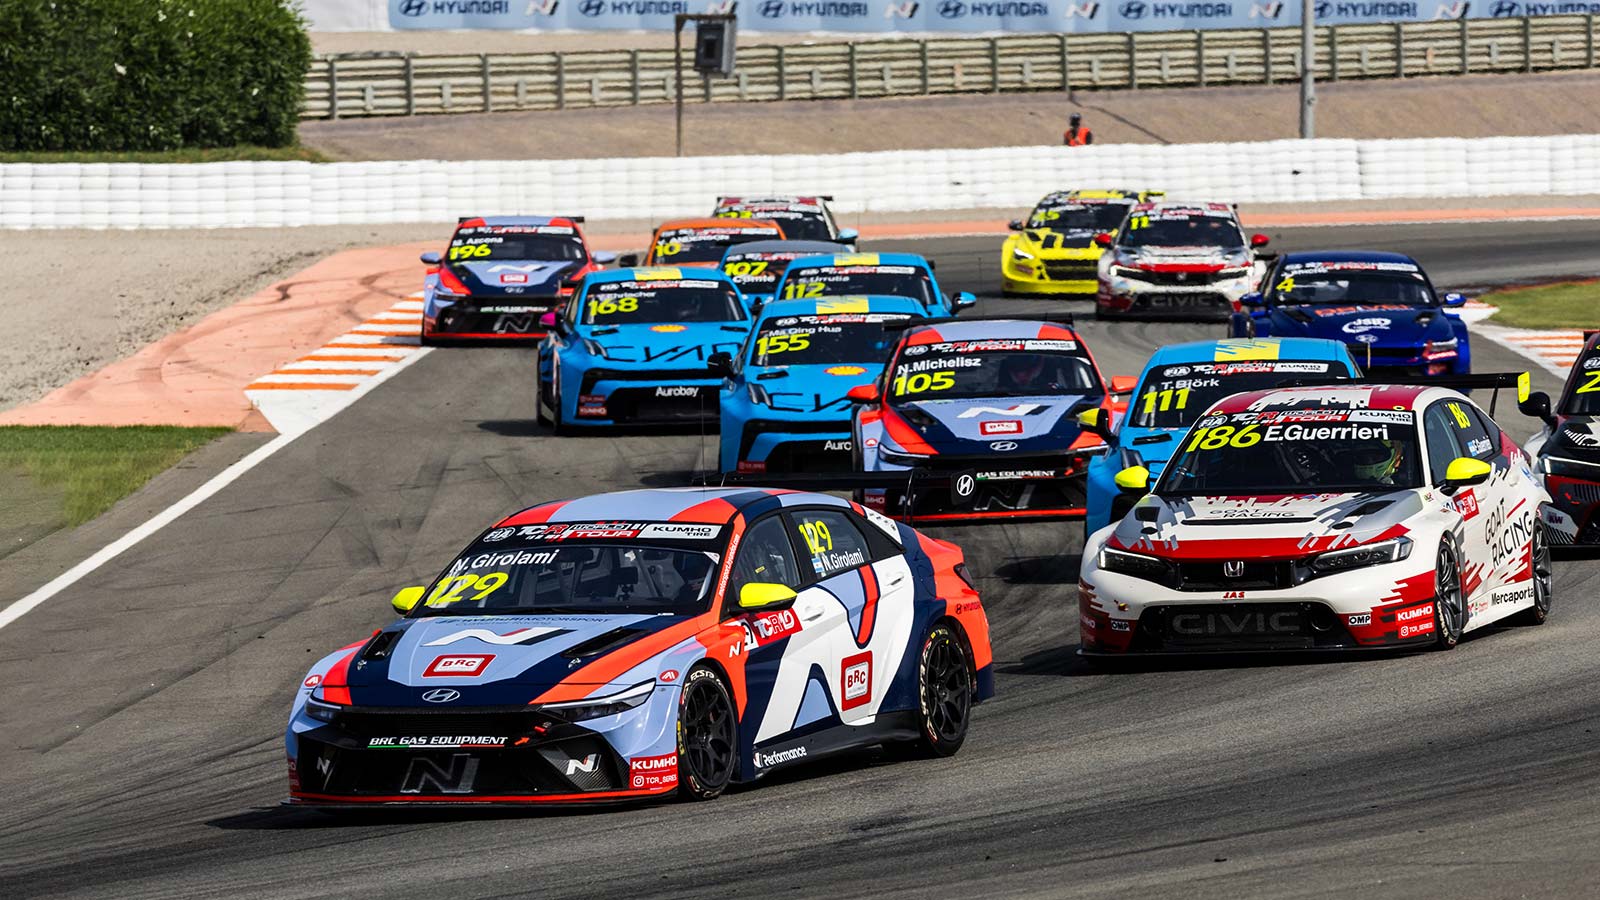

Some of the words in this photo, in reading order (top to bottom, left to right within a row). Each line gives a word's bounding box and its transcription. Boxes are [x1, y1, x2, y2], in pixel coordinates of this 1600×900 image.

[433, 0, 508, 14] HYUNDAI
[612, 1, 687, 14] HYUNDAI
[791, 1, 867, 16] HYUNDAI
[971, 1, 1048, 16] HYUNDAI
[1153, 2, 1232, 17] HYUNDAI
[1337, 2, 1417, 17] HYUNDAI
[450, 244, 491, 260] 196
[655, 243, 680, 257] 10
[724, 262, 768, 276] 107
[785, 282, 825, 299] 112
[1276, 278, 1295, 293] 4
[588, 298, 638, 316] 168
[1151, 292, 1211, 307] CIVIC
[757, 334, 810, 355] 155
[897, 357, 981, 375] N.Michelisz
[1164, 366, 1190, 377] FIA
[895, 371, 955, 396] 105
[1161, 378, 1219, 391] T.Björk
[655, 387, 699, 397] Aurobay
[1143, 388, 1190, 414] 111
[1199, 415, 1228, 429] FIA
[1231, 411, 1279, 422] TCR
[1186, 424, 1261, 452] 186
[1264, 423, 1388, 442] E.Guerrieri
[999, 470, 1055, 478] EQUIPMENT
[1485, 497, 1505, 545] GOAT
[483, 527, 516, 542] FIA
[516, 523, 569, 536] TCR
[576, 530, 634, 538] TOUR
[798, 520, 833, 554] 129
[1492, 511, 1532, 569] RACING
[449, 548, 560, 575] N.Girolami
[822, 548, 864, 571] N.Girolami
[424, 572, 510, 607] 129
[1222, 591, 1245, 599] JAS
[1349, 614, 1371, 625] OMP
[1397, 605, 1432, 621] KUMHO
[1112, 621, 1129, 630] OMP
[1172, 612, 1299, 633] CIVIC
[443, 659, 477, 667] BRC
[847, 669, 866, 689] BRC
[369, 737, 396, 745] BRC
[399, 736, 428, 745] GAS
[430, 736, 508, 745] EQUIPMENT
[632, 757, 677, 770] KUMHO
[763, 745, 808, 767] Performance
